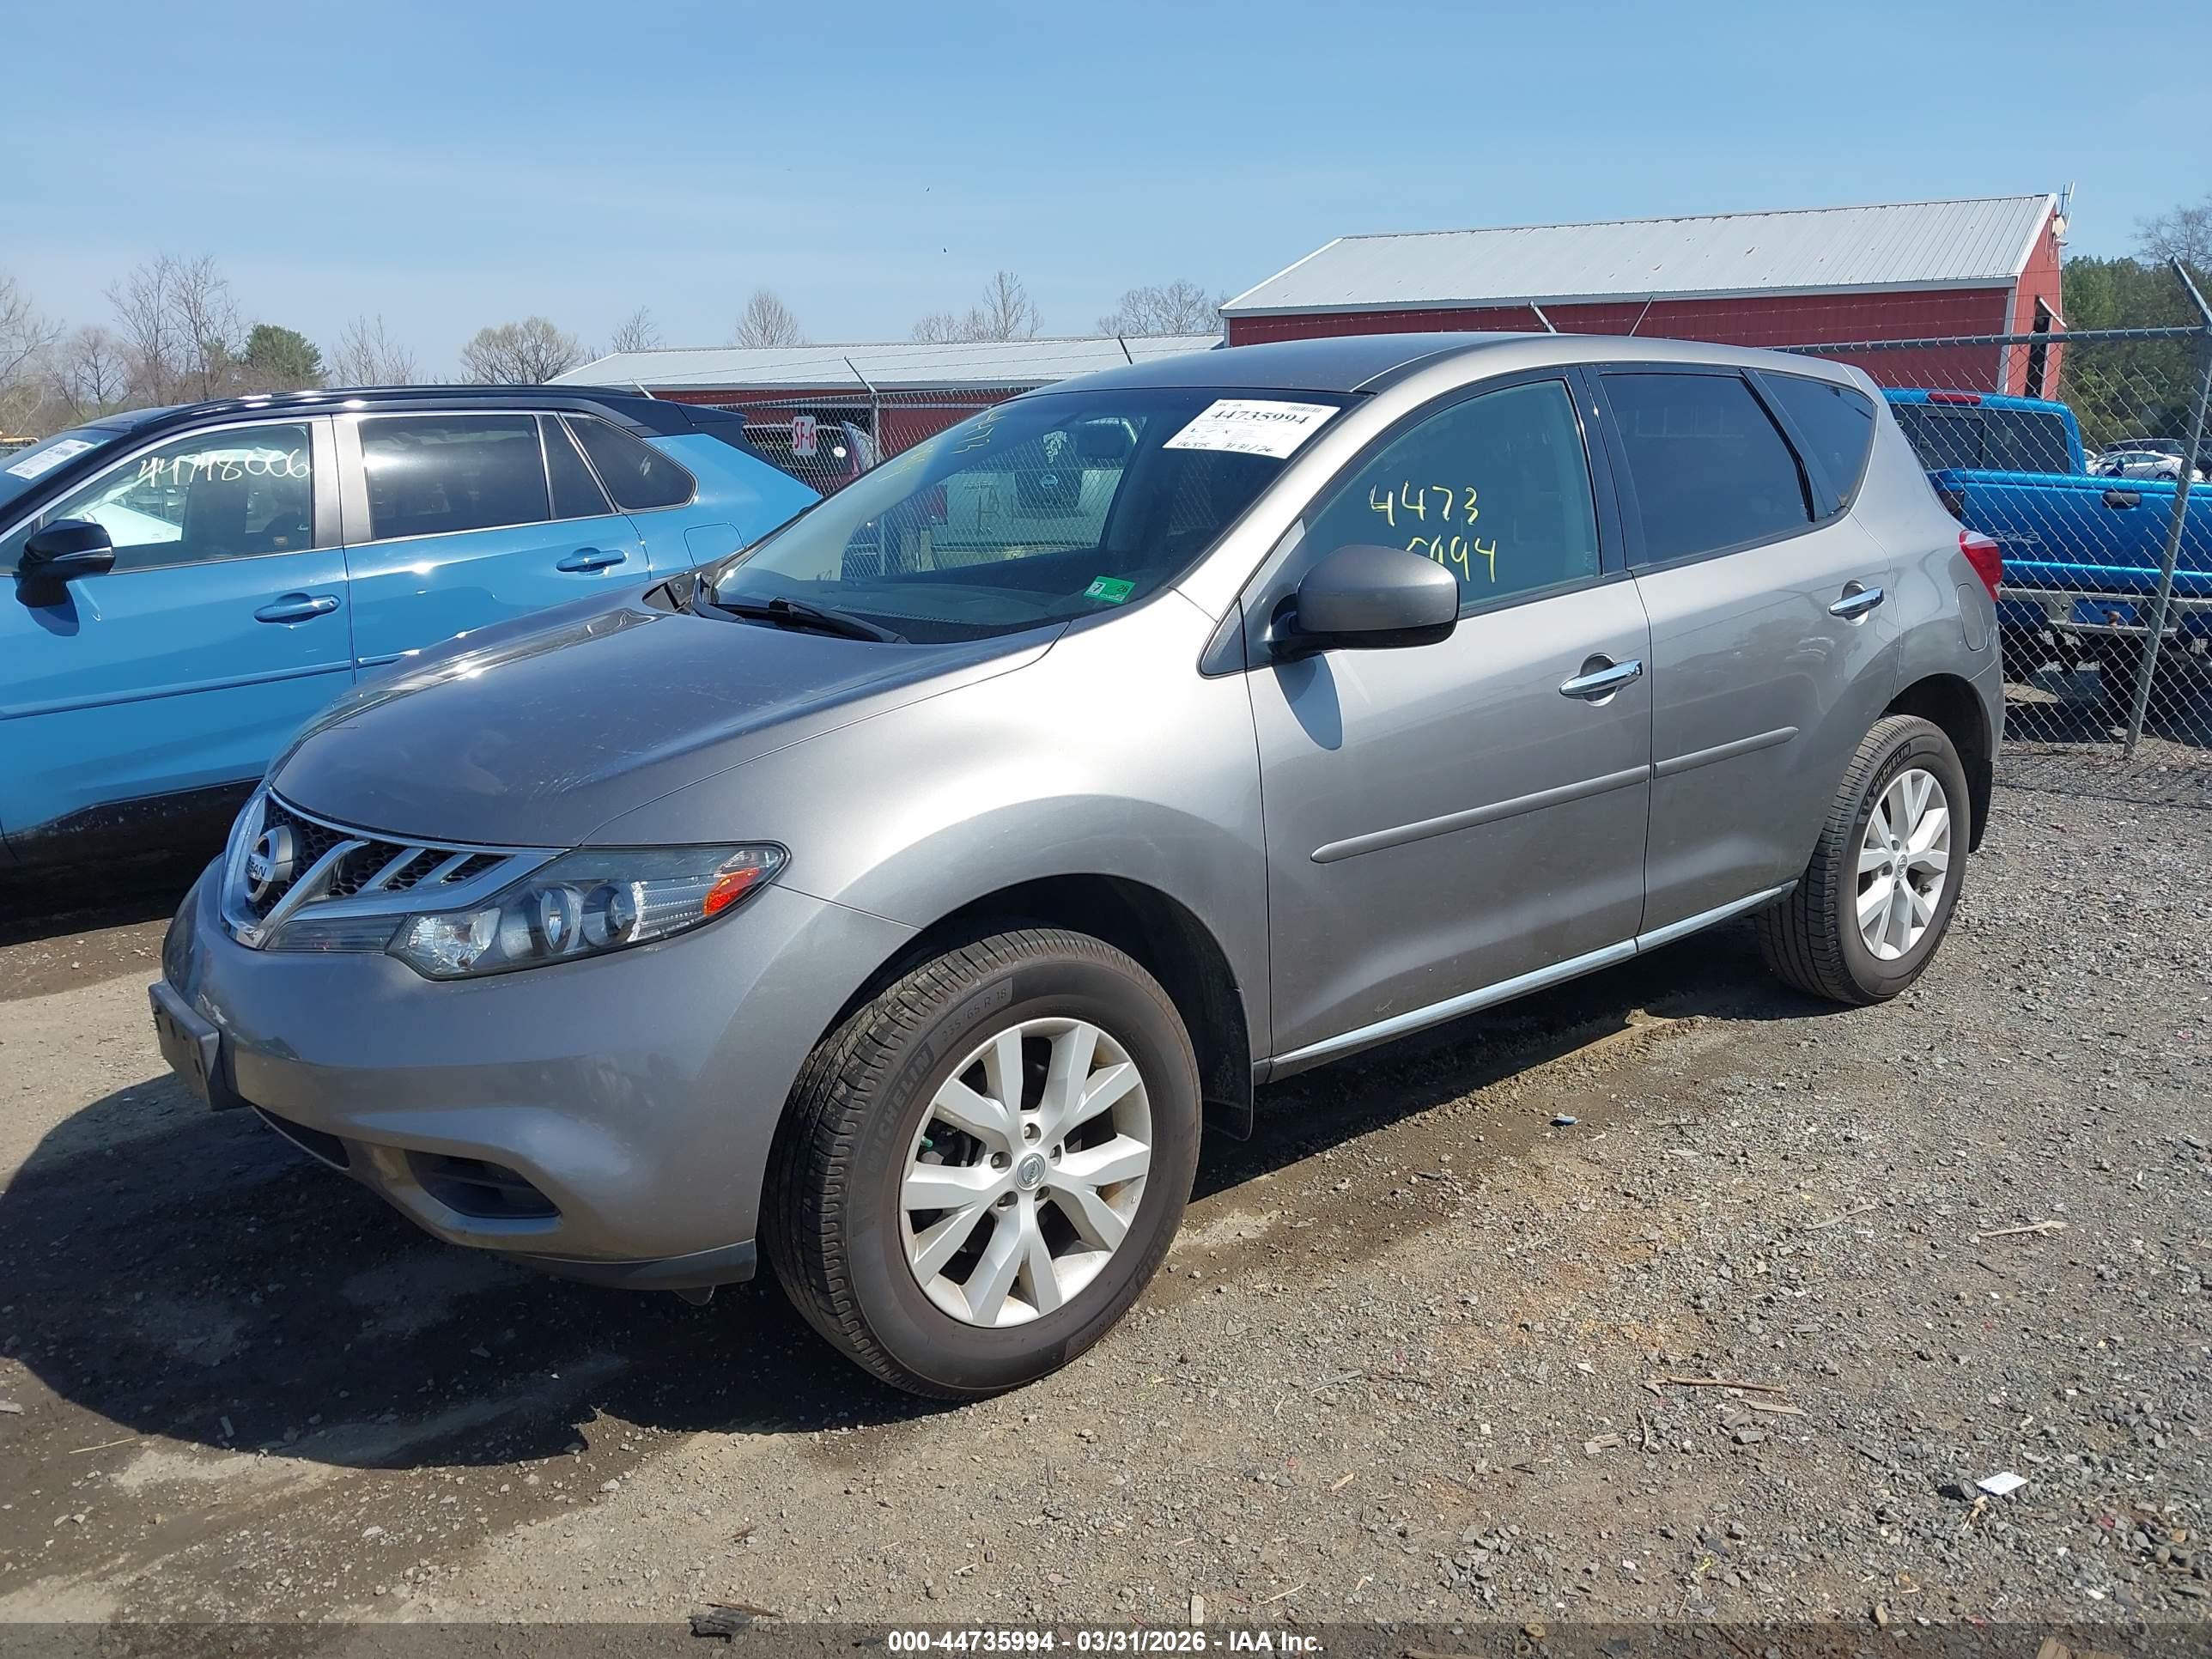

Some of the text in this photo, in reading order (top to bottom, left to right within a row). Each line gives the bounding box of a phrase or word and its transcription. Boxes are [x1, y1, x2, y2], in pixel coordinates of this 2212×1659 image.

[793, 421, 815, 450] SF-6
[1210, 410, 1310, 425] 44735994
[1368, 480, 1480, 527] 4473
[1093, 583, 1103, 592] 7
[1873, 744, 1911, 795] MICHELIN
[866, 1049, 933, 1175] MICHELIN
